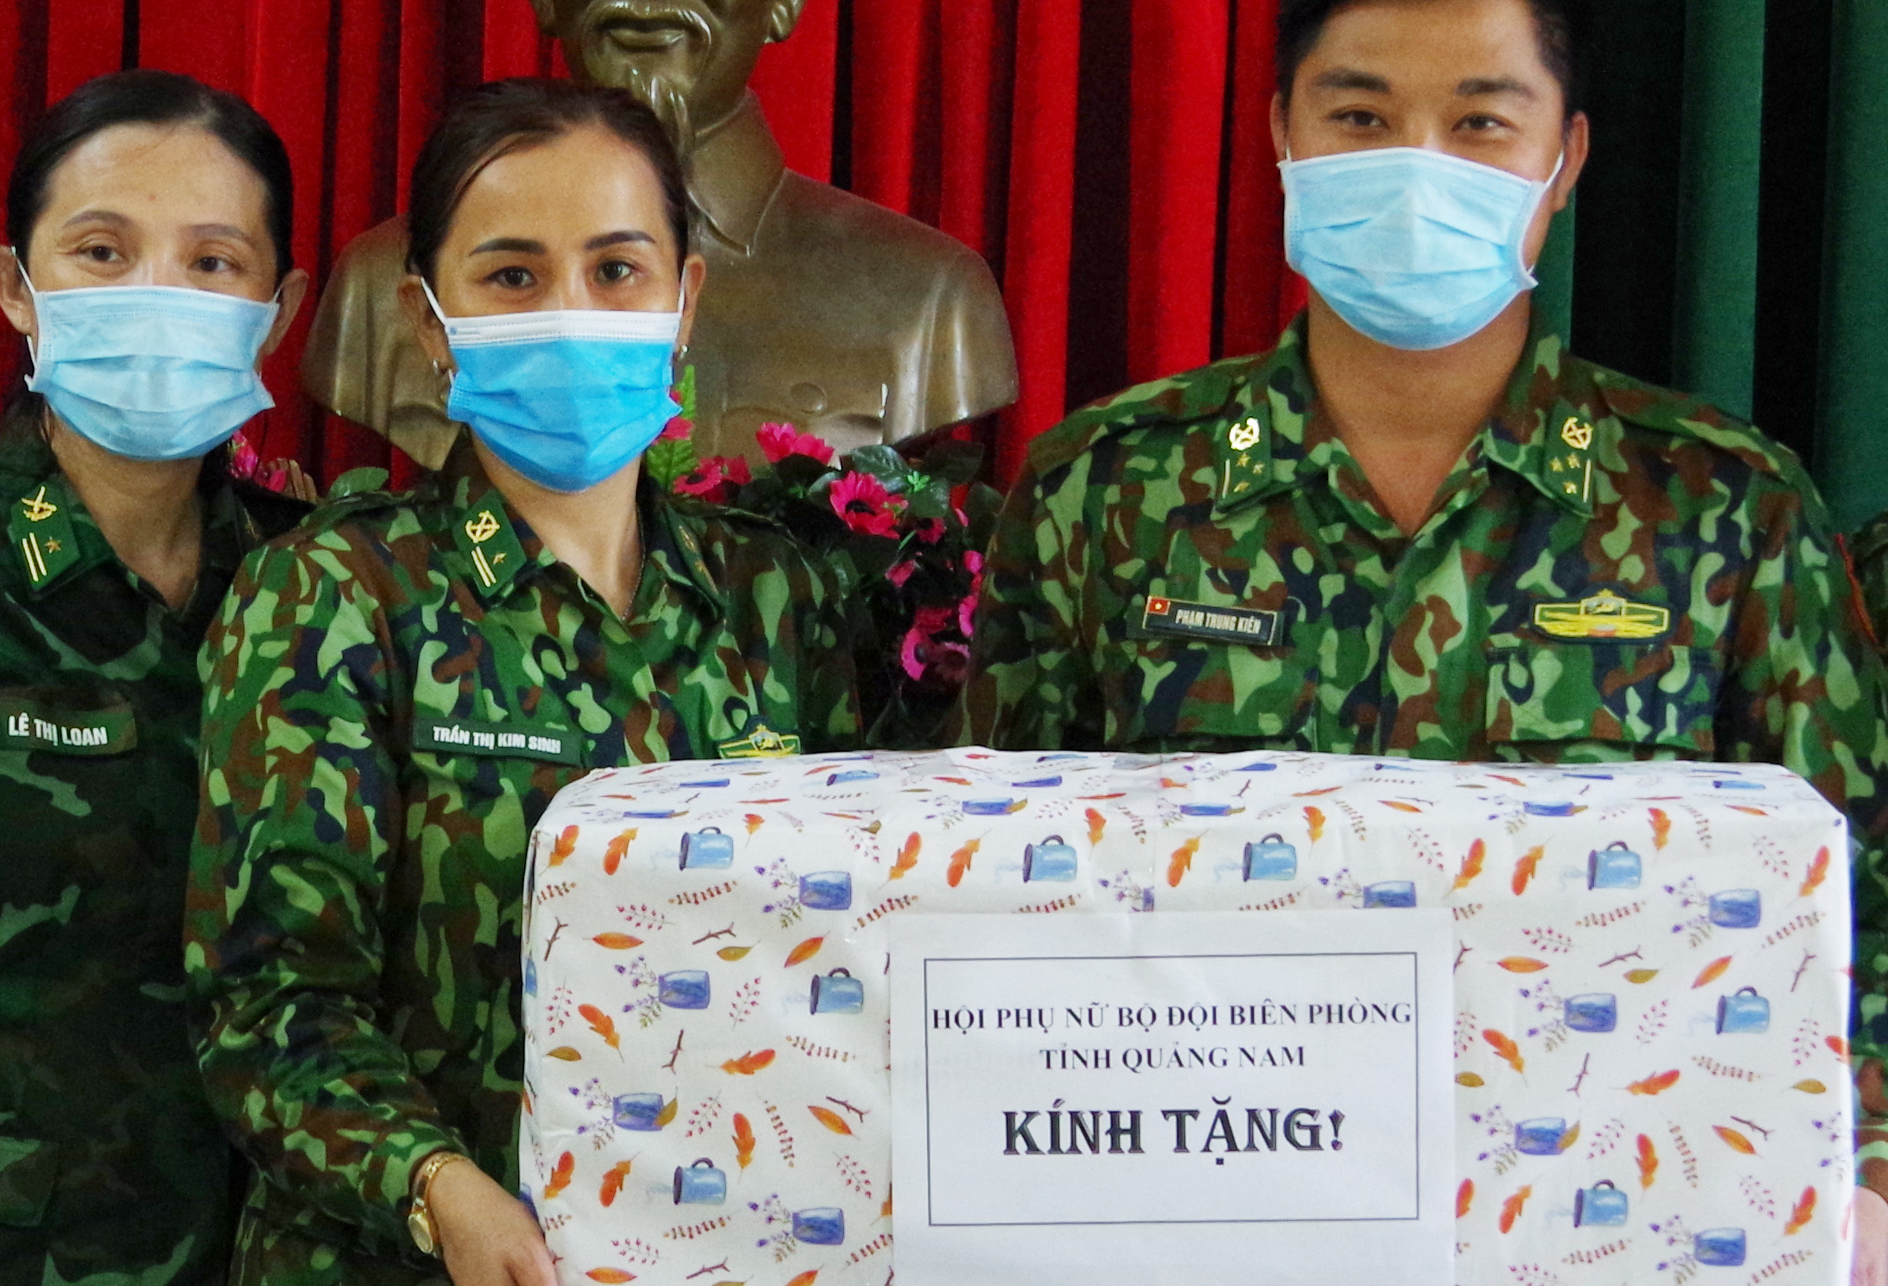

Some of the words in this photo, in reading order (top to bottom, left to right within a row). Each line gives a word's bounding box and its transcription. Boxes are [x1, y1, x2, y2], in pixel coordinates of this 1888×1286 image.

[8, 712, 30, 736] LÊ
[33, 718, 58, 746] THỊ
[61, 726, 108, 746] LOAN
[472, 731, 495, 750] THỊ
[497, 732, 526, 748] KIM
[527, 735, 562, 754] SINH
[932, 1005, 985, 1035] HỘI
[997, 1006, 1054, 1034] PHỤ
[1065, 1001, 1110, 1028] NỮ
[1117, 1003, 1157, 1033] BỘ
[1167, 1002, 1218, 1032] ĐỘI
[1229, 998, 1297, 1026] BIÊN
[1308, 996, 1412, 1024] PHÒNG
[1039, 1042, 1113, 1070] TỈNH
[1121, 1041, 1228, 1073] QUẢNG
[1238, 1045, 1305, 1068] NAM
[1002, 1098, 1145, 1155] KÍNH
[1161, 1095, 1345, 1166] TẶNG!
